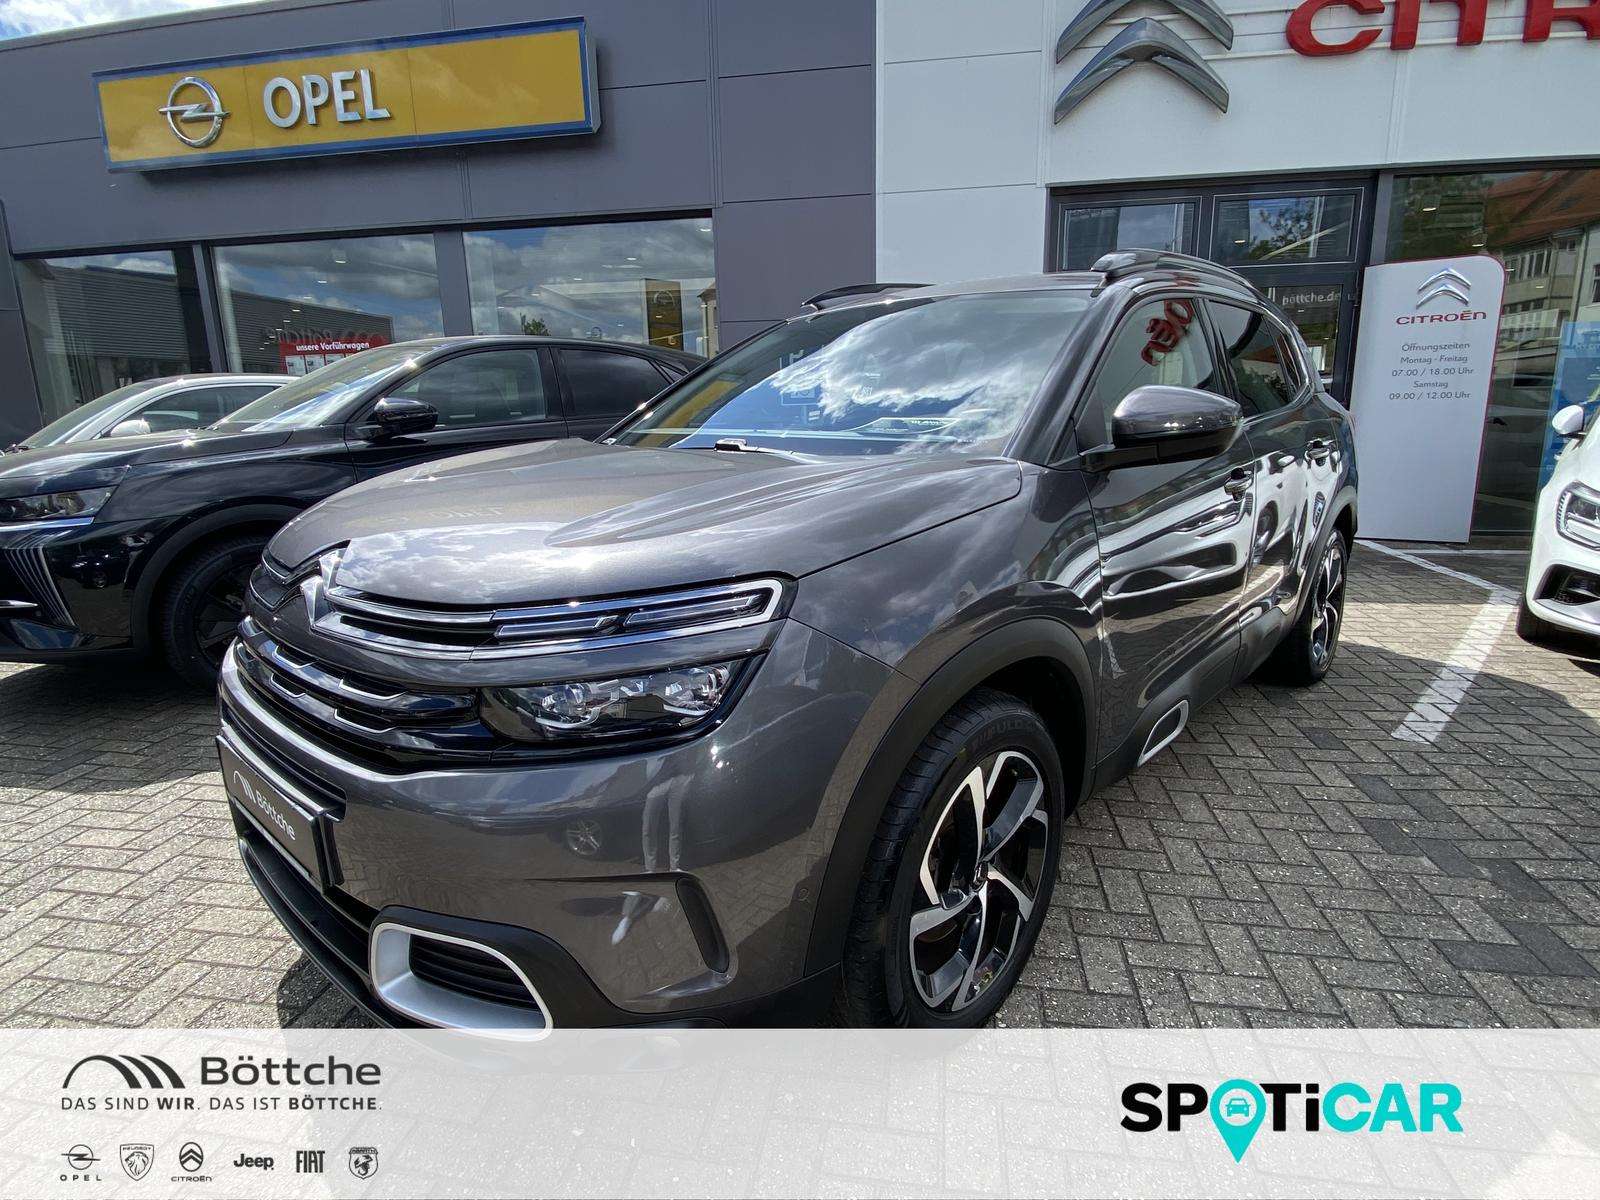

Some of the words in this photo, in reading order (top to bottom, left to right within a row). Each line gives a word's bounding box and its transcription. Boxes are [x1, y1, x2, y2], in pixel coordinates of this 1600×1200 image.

[263, 69, 391, 128] OPEL
[320, 341, 370, 351] Vorführwagen
[1400, 357, 1432, 365] Montag
[1439, 355, 1468, 363] Freitag
[1413, 381, 1449, 389] Samstag
[256, 790, 296, 840] Böttche
